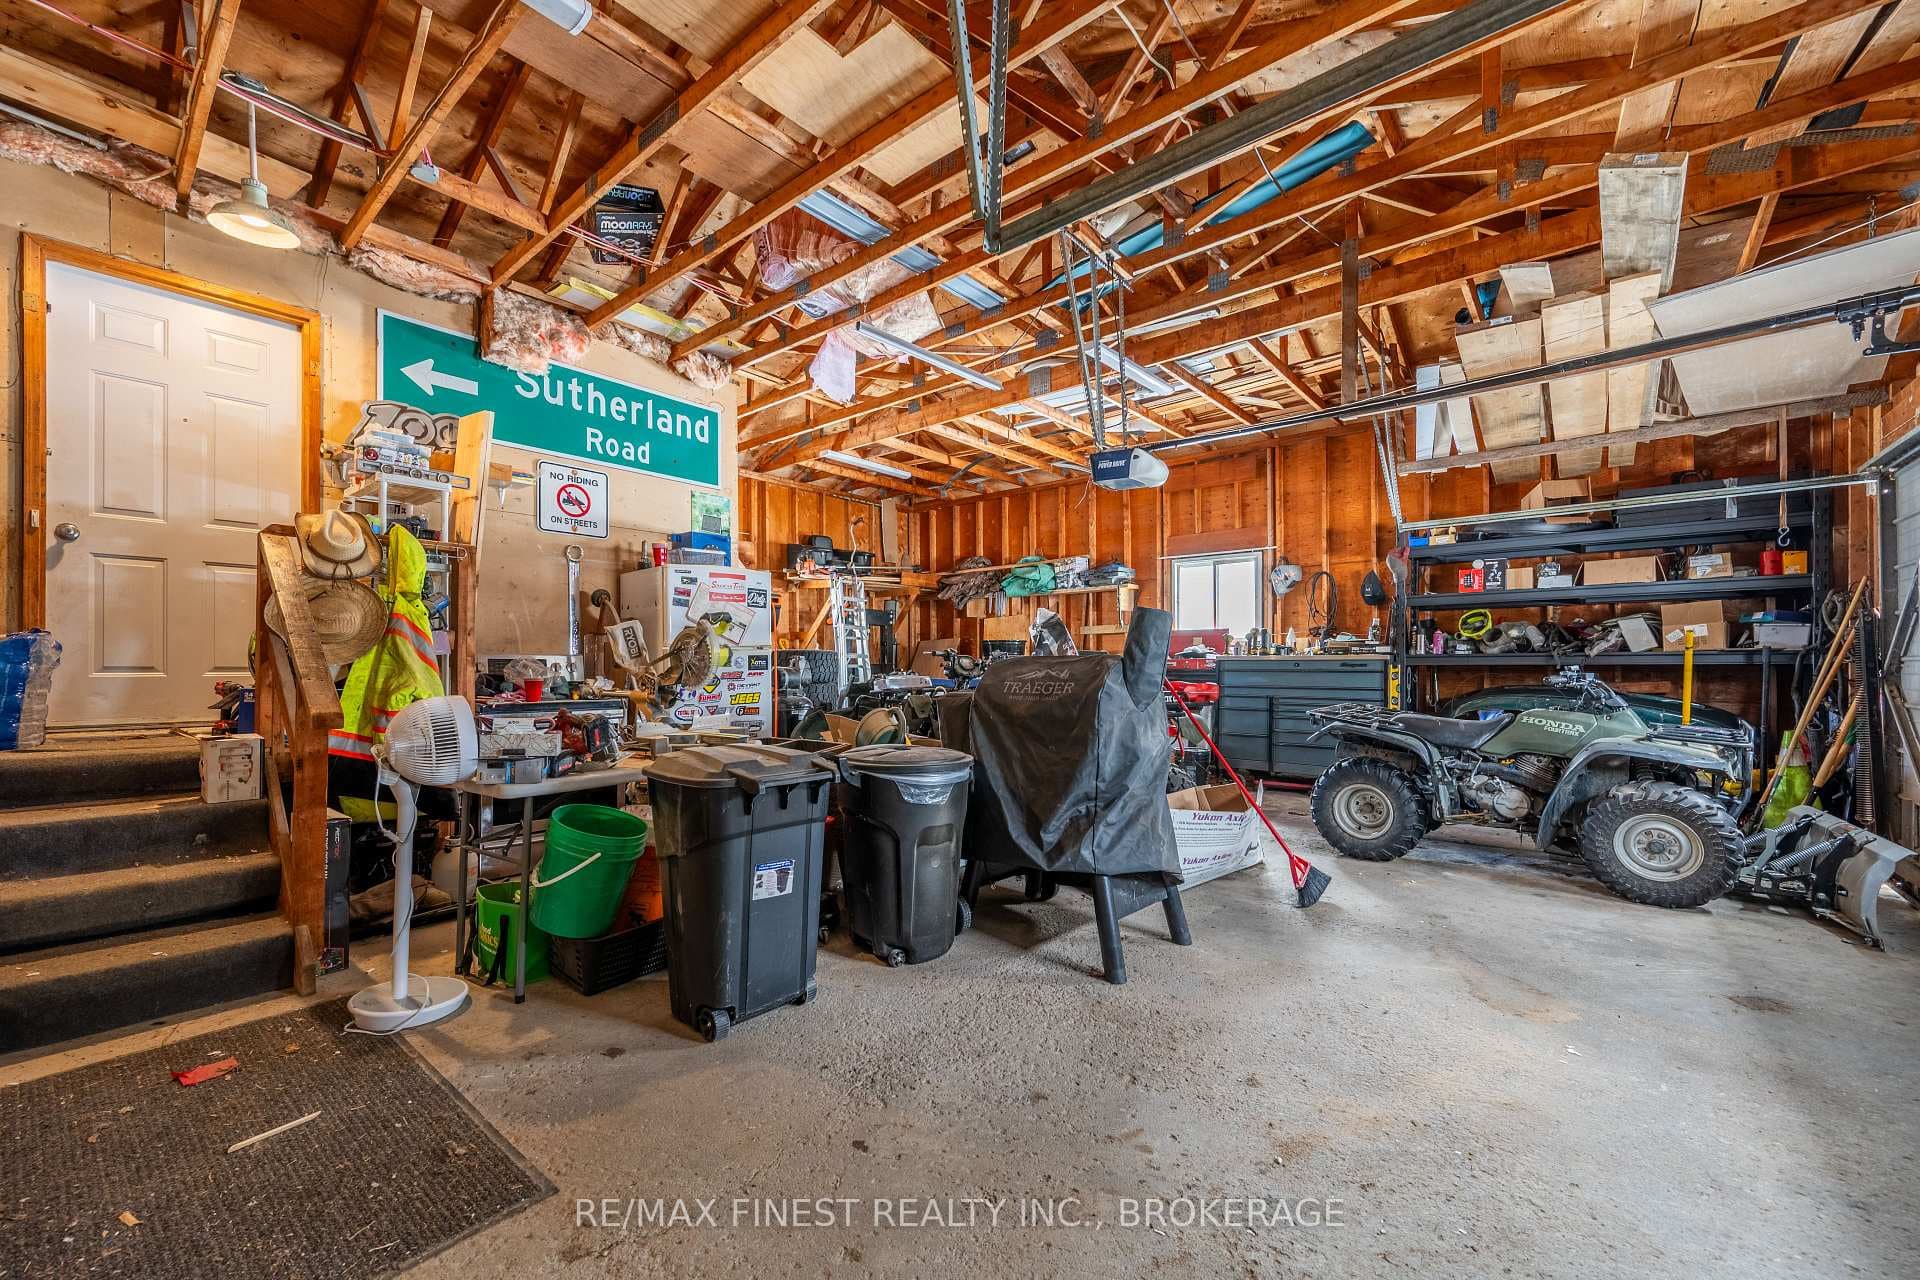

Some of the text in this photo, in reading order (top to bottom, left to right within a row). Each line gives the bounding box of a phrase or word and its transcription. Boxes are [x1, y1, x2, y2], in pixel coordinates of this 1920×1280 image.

[514, 372, 710, 444] Sutherland
[586, 427, 650, 465] Road
[549, 471, 599, 487] NO RIDING
[550, 515, 598, 529] ON STREETS
[623, 627, 641, 657] RYOBI
[1003, 681, 1075, 695] TRAEGER
[731, 692, 761, 705] JEGS
[1520, 716, 1586, 733] HONDA
[1191, 812, 1223, 822] Yukon
